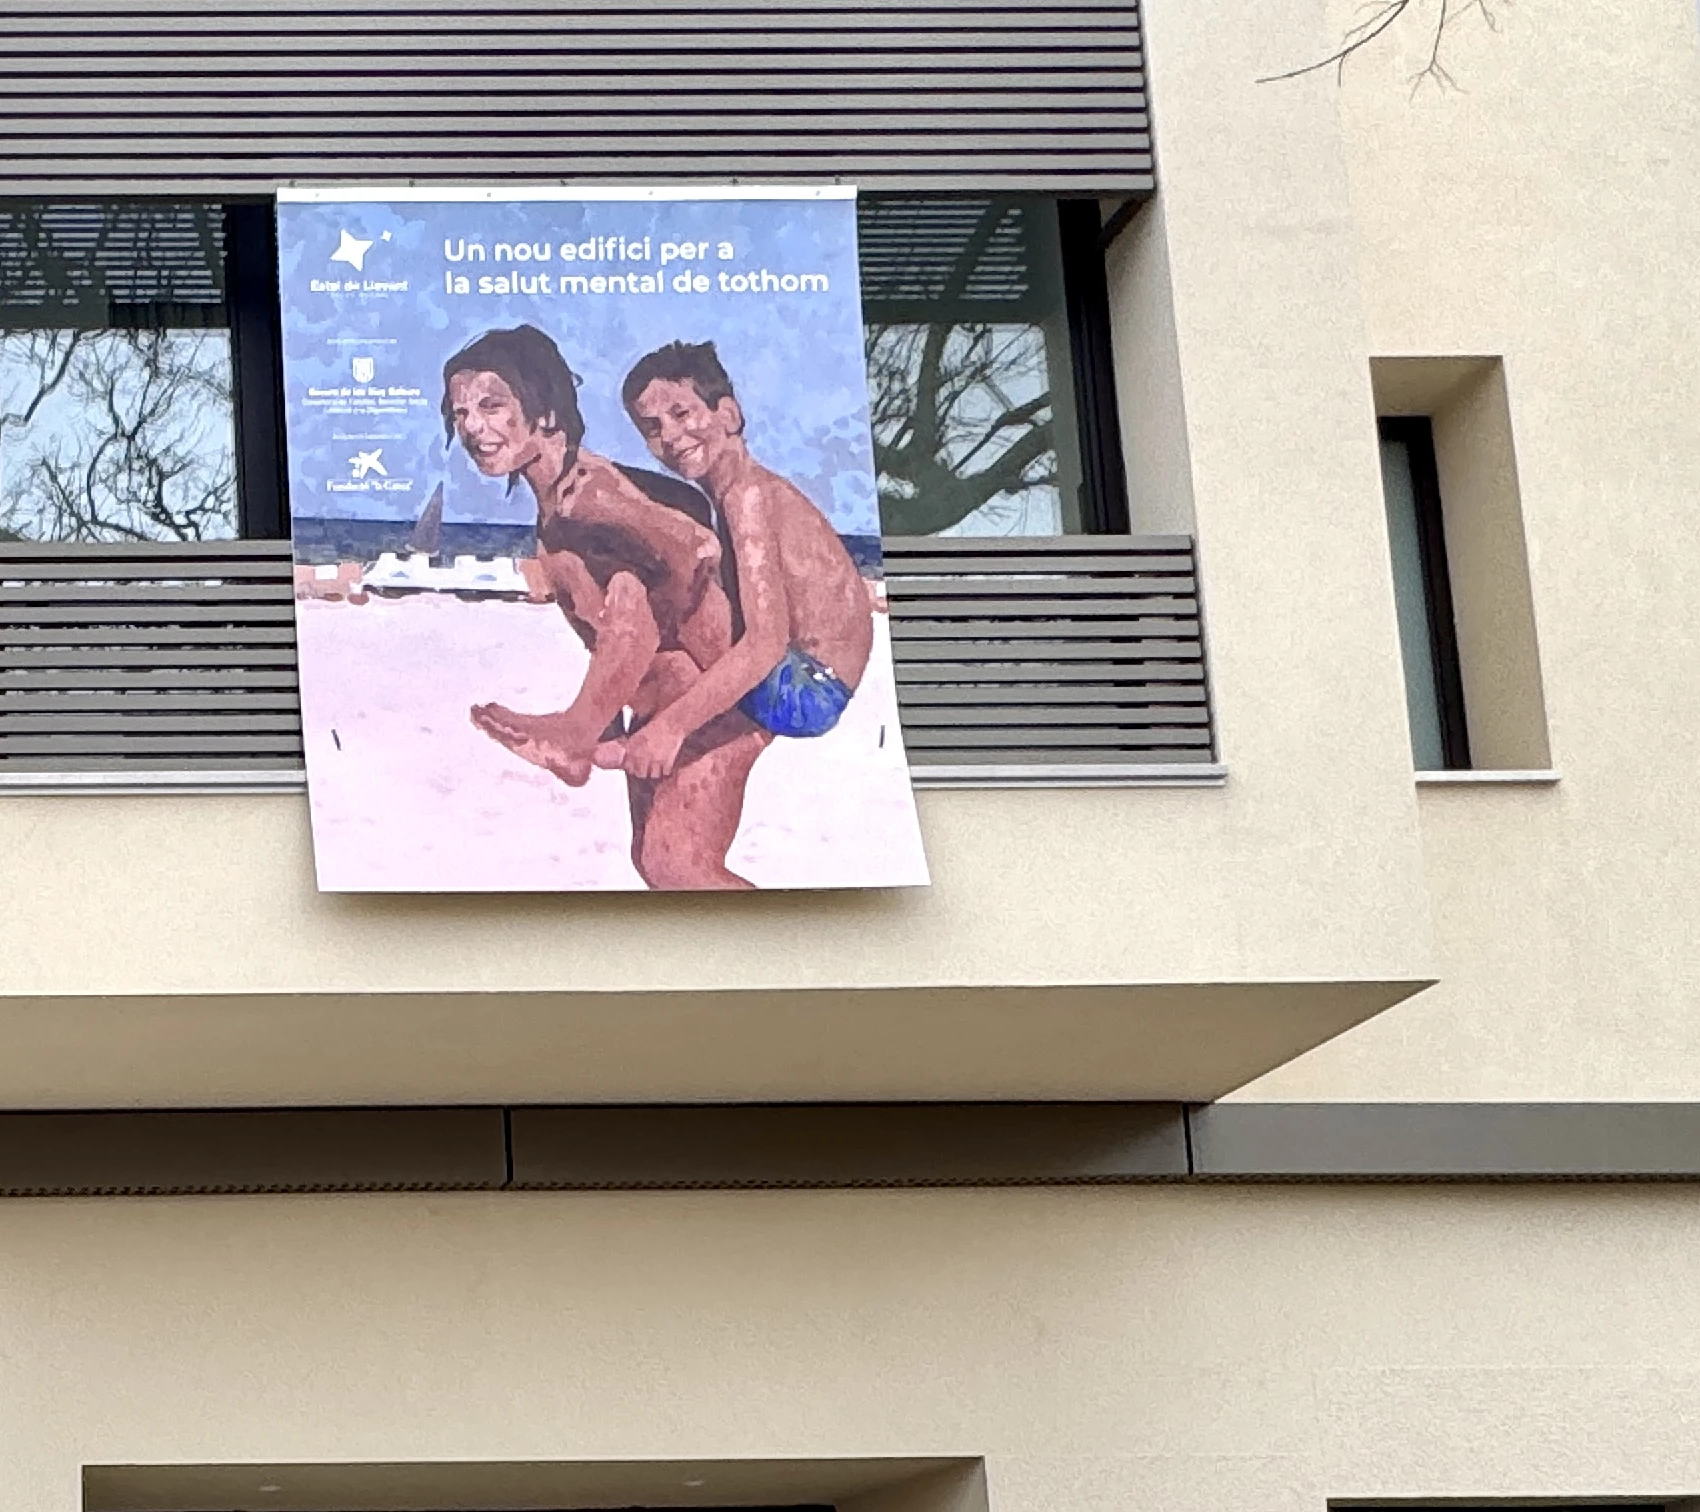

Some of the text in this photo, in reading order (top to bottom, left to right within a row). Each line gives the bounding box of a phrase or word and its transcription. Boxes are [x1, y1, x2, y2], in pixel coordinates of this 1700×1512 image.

[444, 236, 734, 265] Un nou edifici per a
[445, 268, 829, 294] la salut mental de tothom
